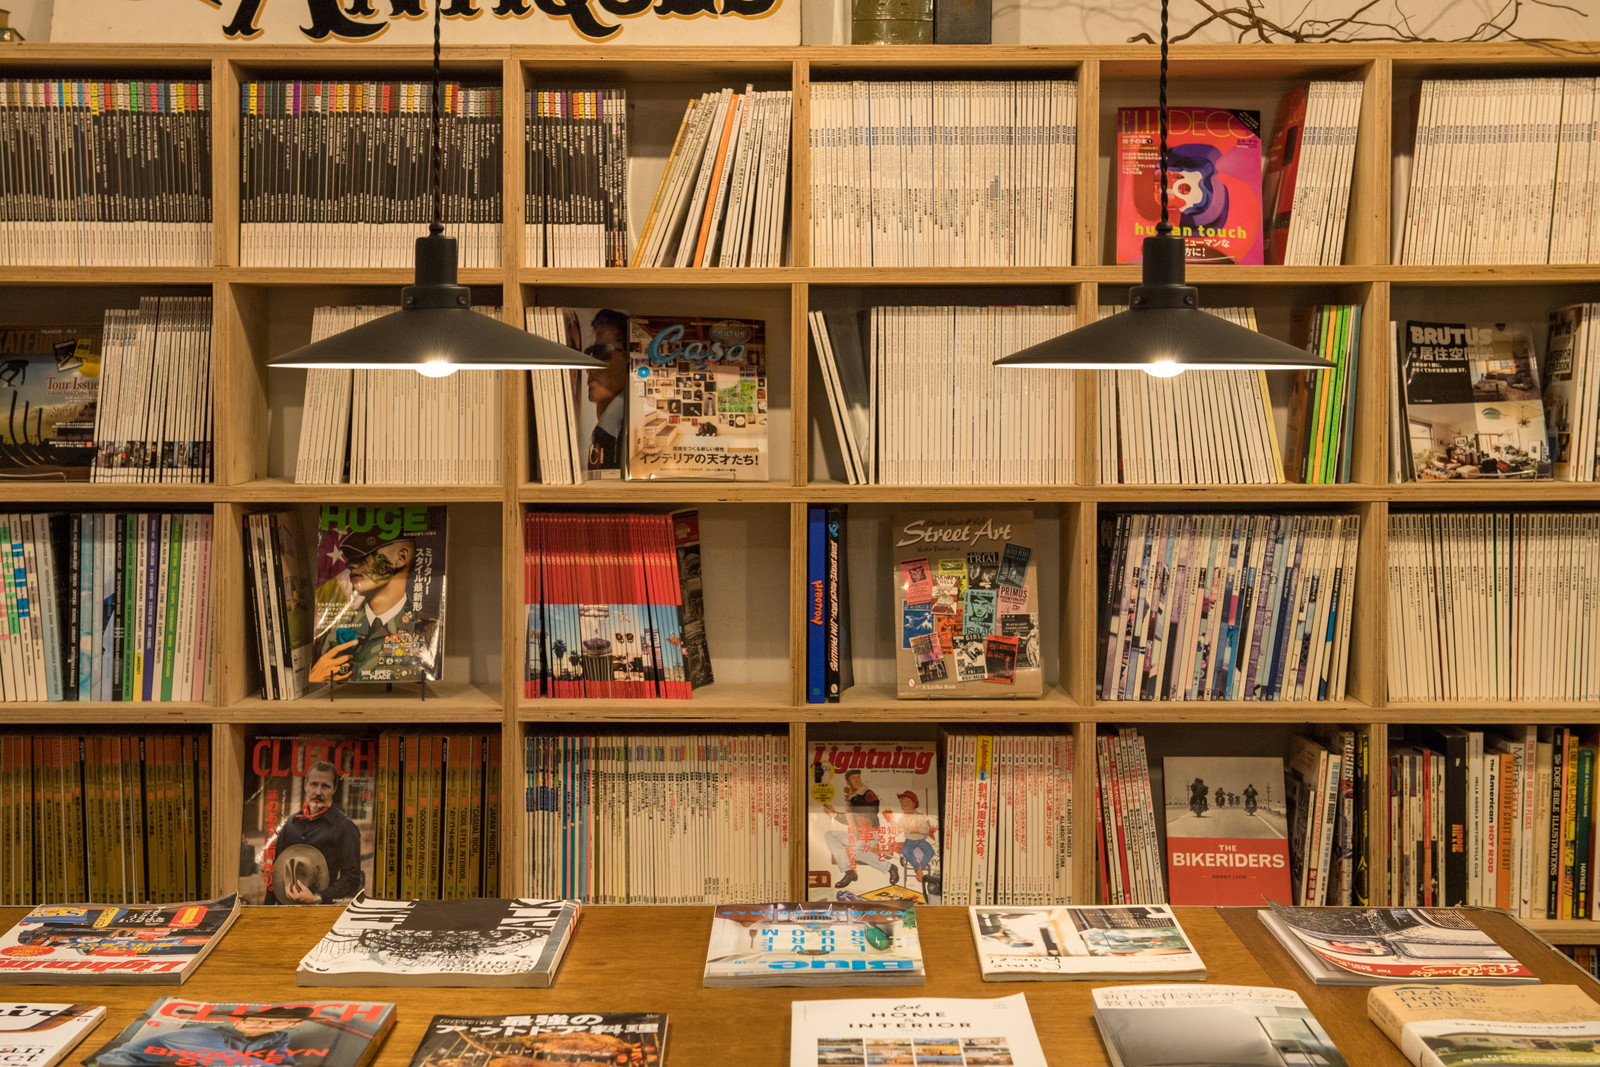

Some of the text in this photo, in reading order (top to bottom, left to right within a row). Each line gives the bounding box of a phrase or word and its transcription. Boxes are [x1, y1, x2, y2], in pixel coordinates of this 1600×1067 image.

[1122, 110, 1161, 134] ELL
[1134, 222, 1247, 238] huan touch
[648, 324, 746, 364] Casa
[1410, 326, 1493, 345] BRUTUS
[48, 376, 100, 390] Tour Issue
[896, 518, 1012, 547] Street Art
[968, 555, 998, 563] TRIAL
[412, 548, 424, 612] スタイル最新形
[424, 548, 434, 596] ミリタリー
[1000, 586, 1028, 598] PRIMUS
[252, 740, 375, 778] CLUTCH
[810, 746, 934, 775] Lightning
[981, 739, 990, 770] Lightning
[1553, 767, 1561, 788] DORÉ
[1552, 790, 1560, 812] BIBLE
[975, 782, 988, 860] 創刊14周年特大号。
[1218, 844, 1237, 852] THE
[1452, 824, 1464, 853] HIPPIE
[1502, 837, 1511, 846] TO
[1550, 815, 1559, 876] ILLUSTRATIONS
[1172, 852, 1285, 868] BIKERIDERS
[436, 1024, 659, 1036] アウトドア料理
[500, 1014, 604, 1026] 最強の
[144, 1046, 330, 1058] BROOKLYN
